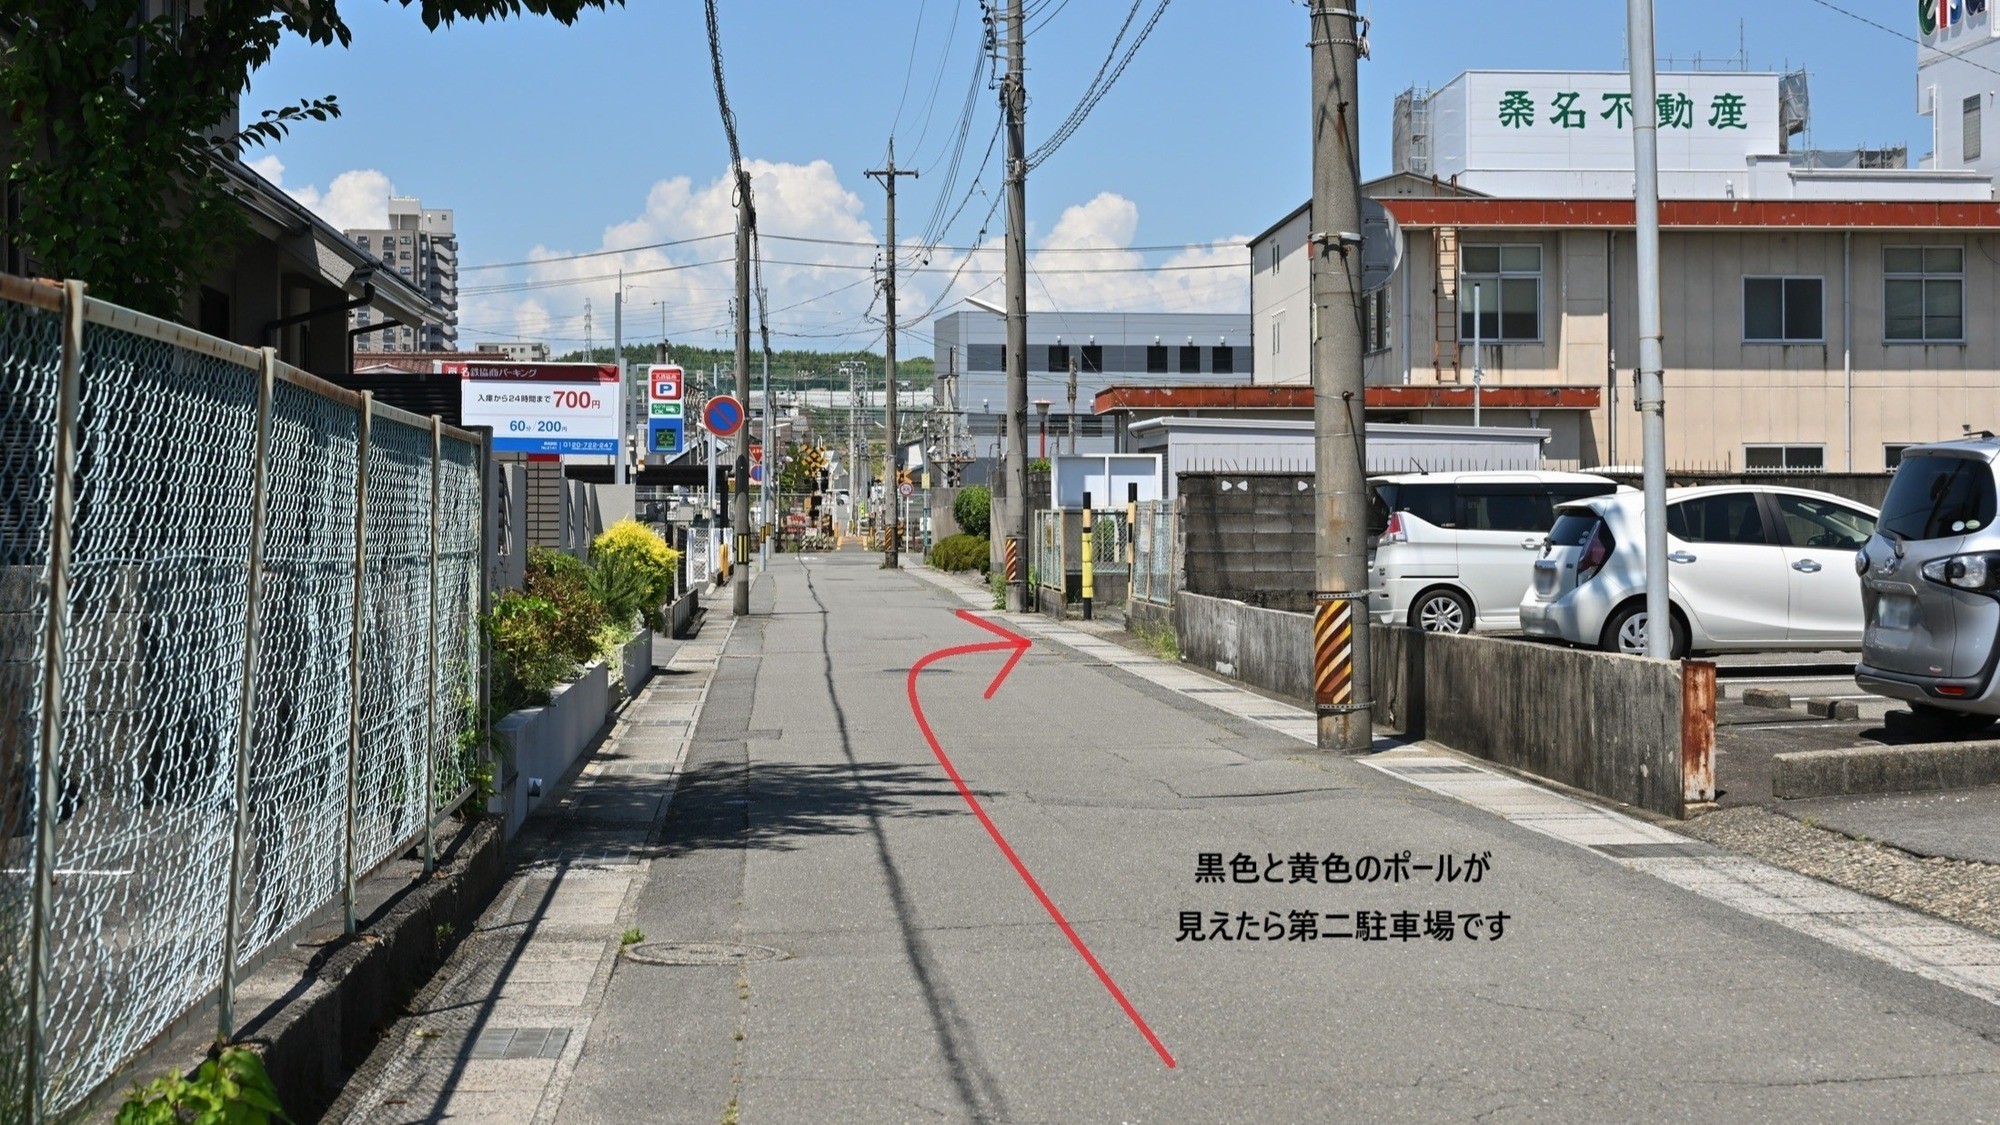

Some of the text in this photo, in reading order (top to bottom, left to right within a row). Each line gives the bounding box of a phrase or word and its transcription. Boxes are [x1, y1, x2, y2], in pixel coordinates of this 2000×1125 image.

[1499, 90, 1748, 129] 桑名不動産
[461, 366, 537, 378] 名鉄協商パーキング
[660, 384, 672, 394] P
[477, 390, 601, 409] 入庫から24時間まで 700円
